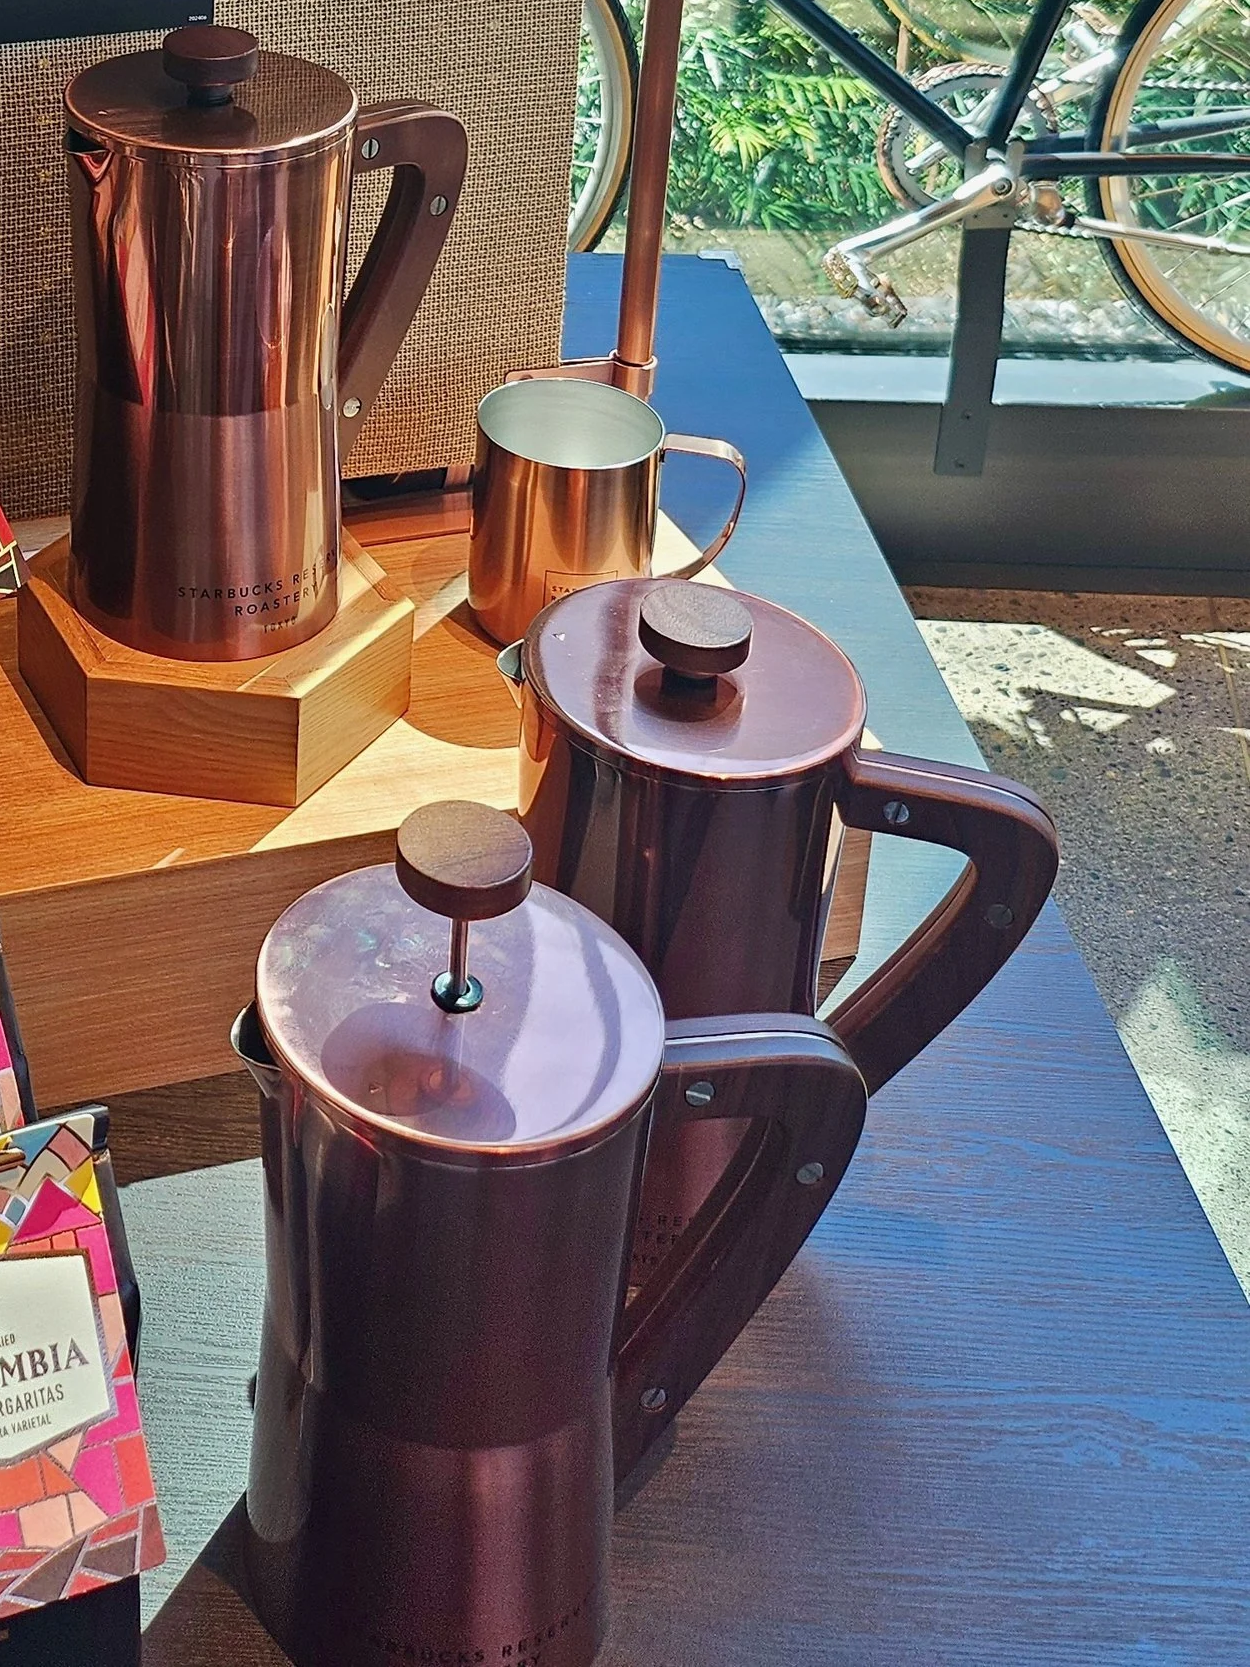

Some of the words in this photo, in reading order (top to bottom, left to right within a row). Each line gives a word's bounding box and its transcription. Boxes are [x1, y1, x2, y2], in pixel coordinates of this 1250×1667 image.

[178, 579, 283, 599] STARBUCKS
[235, 582, 317, 616] ROASTERY
[263, 615, 298, 634] TOKYO
[11, 1413, 52, 1434] VARIETAL
